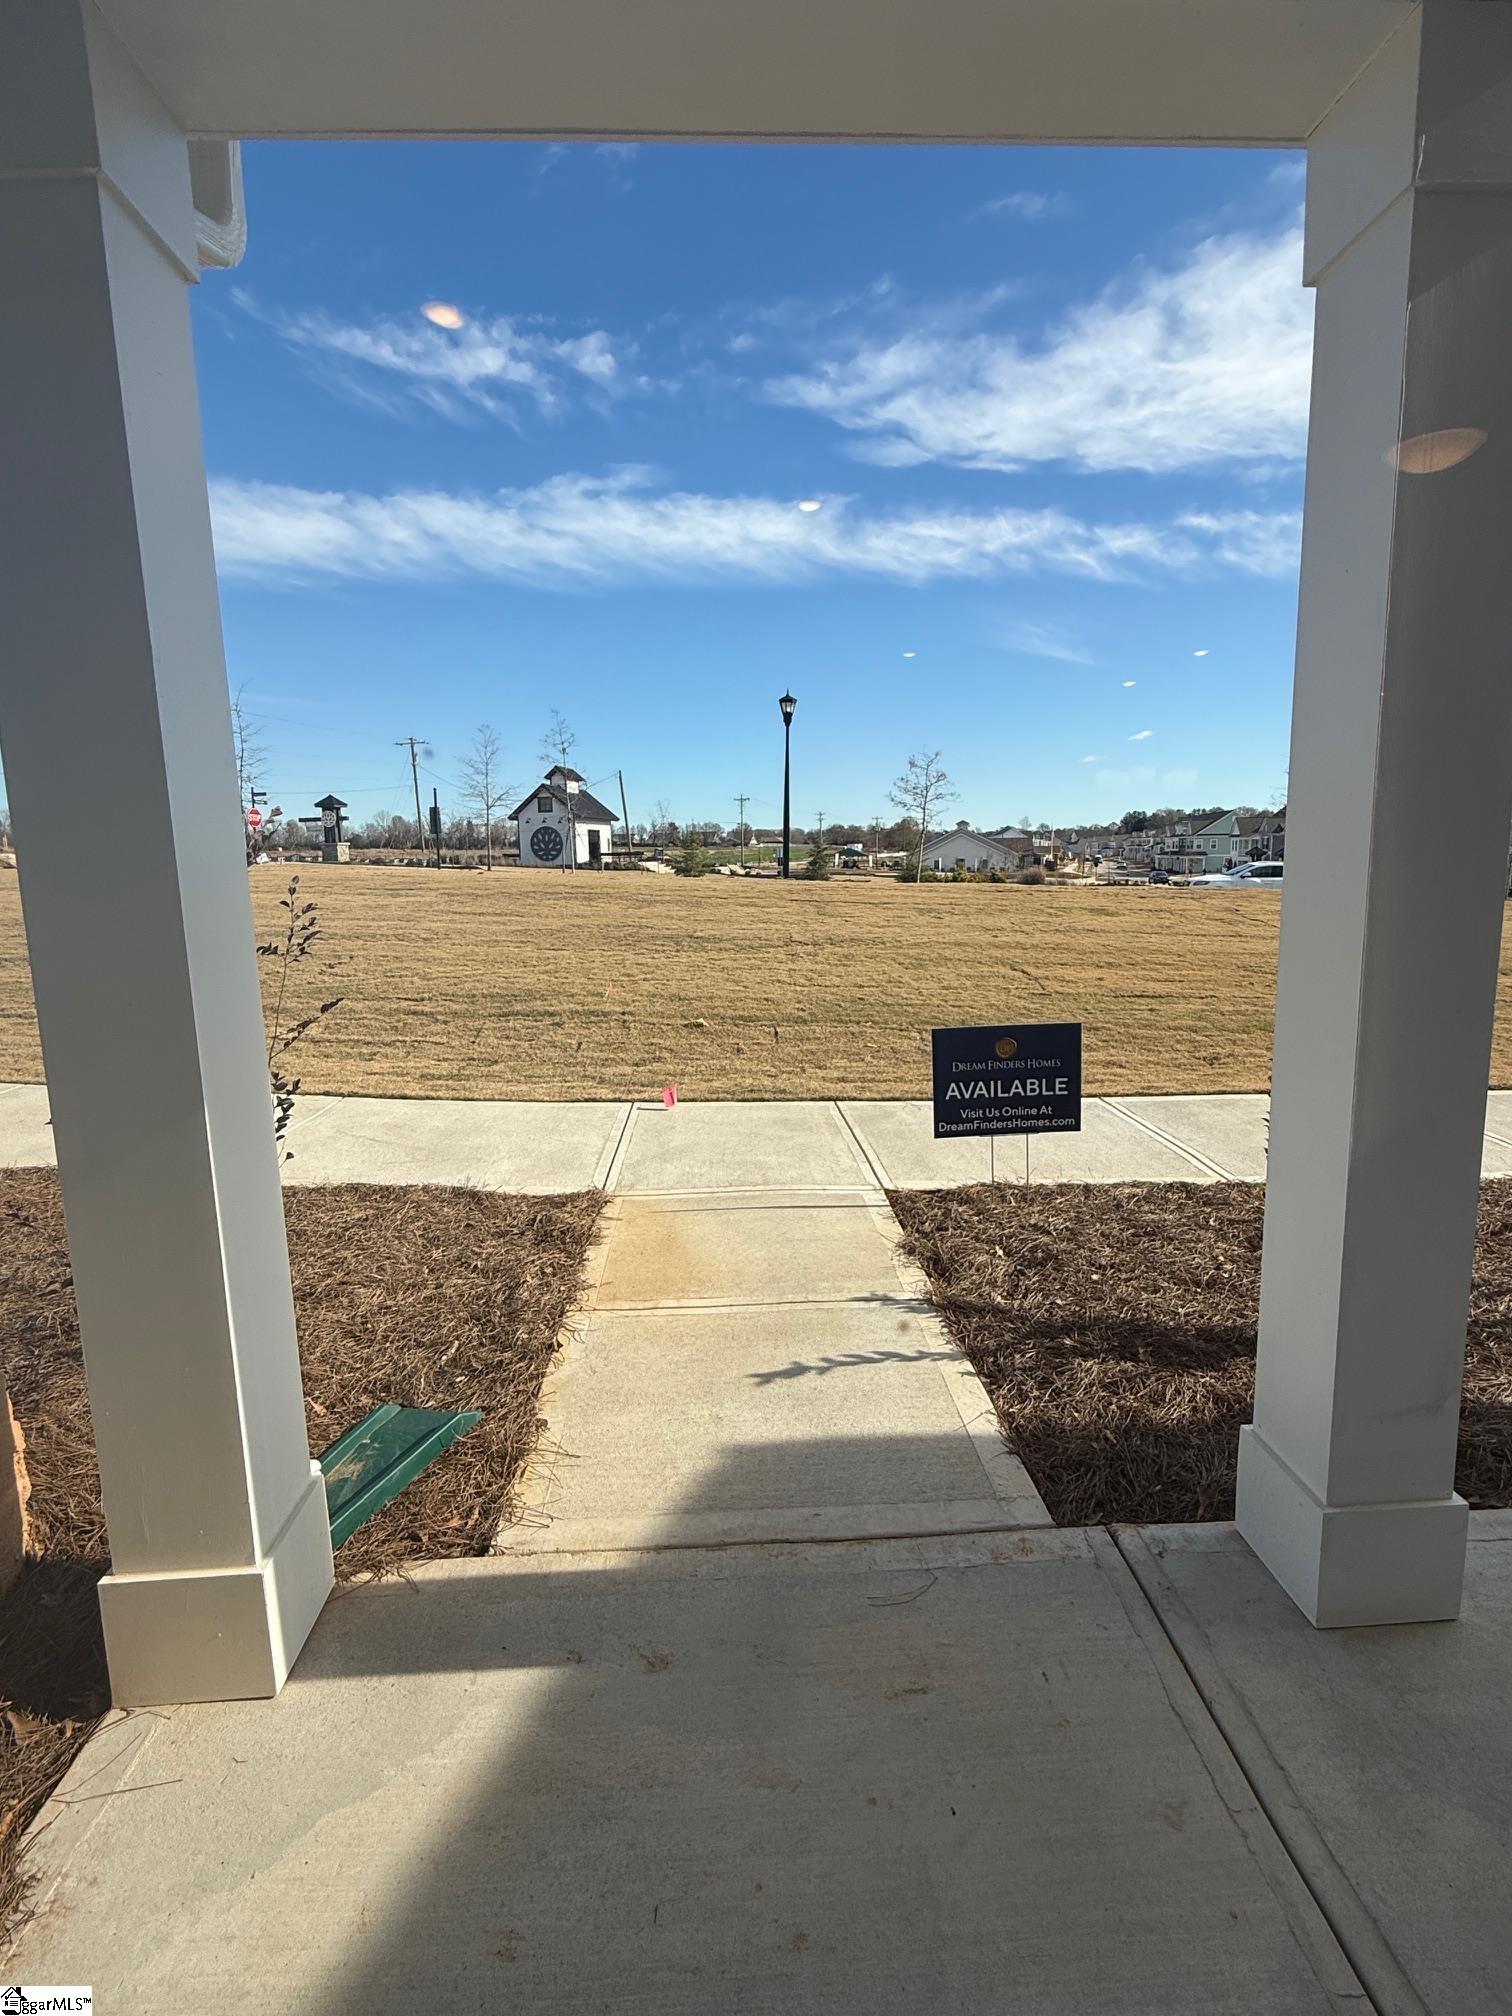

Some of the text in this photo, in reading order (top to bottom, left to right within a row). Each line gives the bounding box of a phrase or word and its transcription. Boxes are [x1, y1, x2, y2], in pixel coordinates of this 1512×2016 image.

[952, 1058, 1061, 1072] DREAM FINDERS HOMES
[945, 1077, 1069, 1100] AVAILABLE
[960, 1105, 1053, 1118] Visit Us Online At
[938, 1117, 1075, 1132] DreamFindersHomes.com
